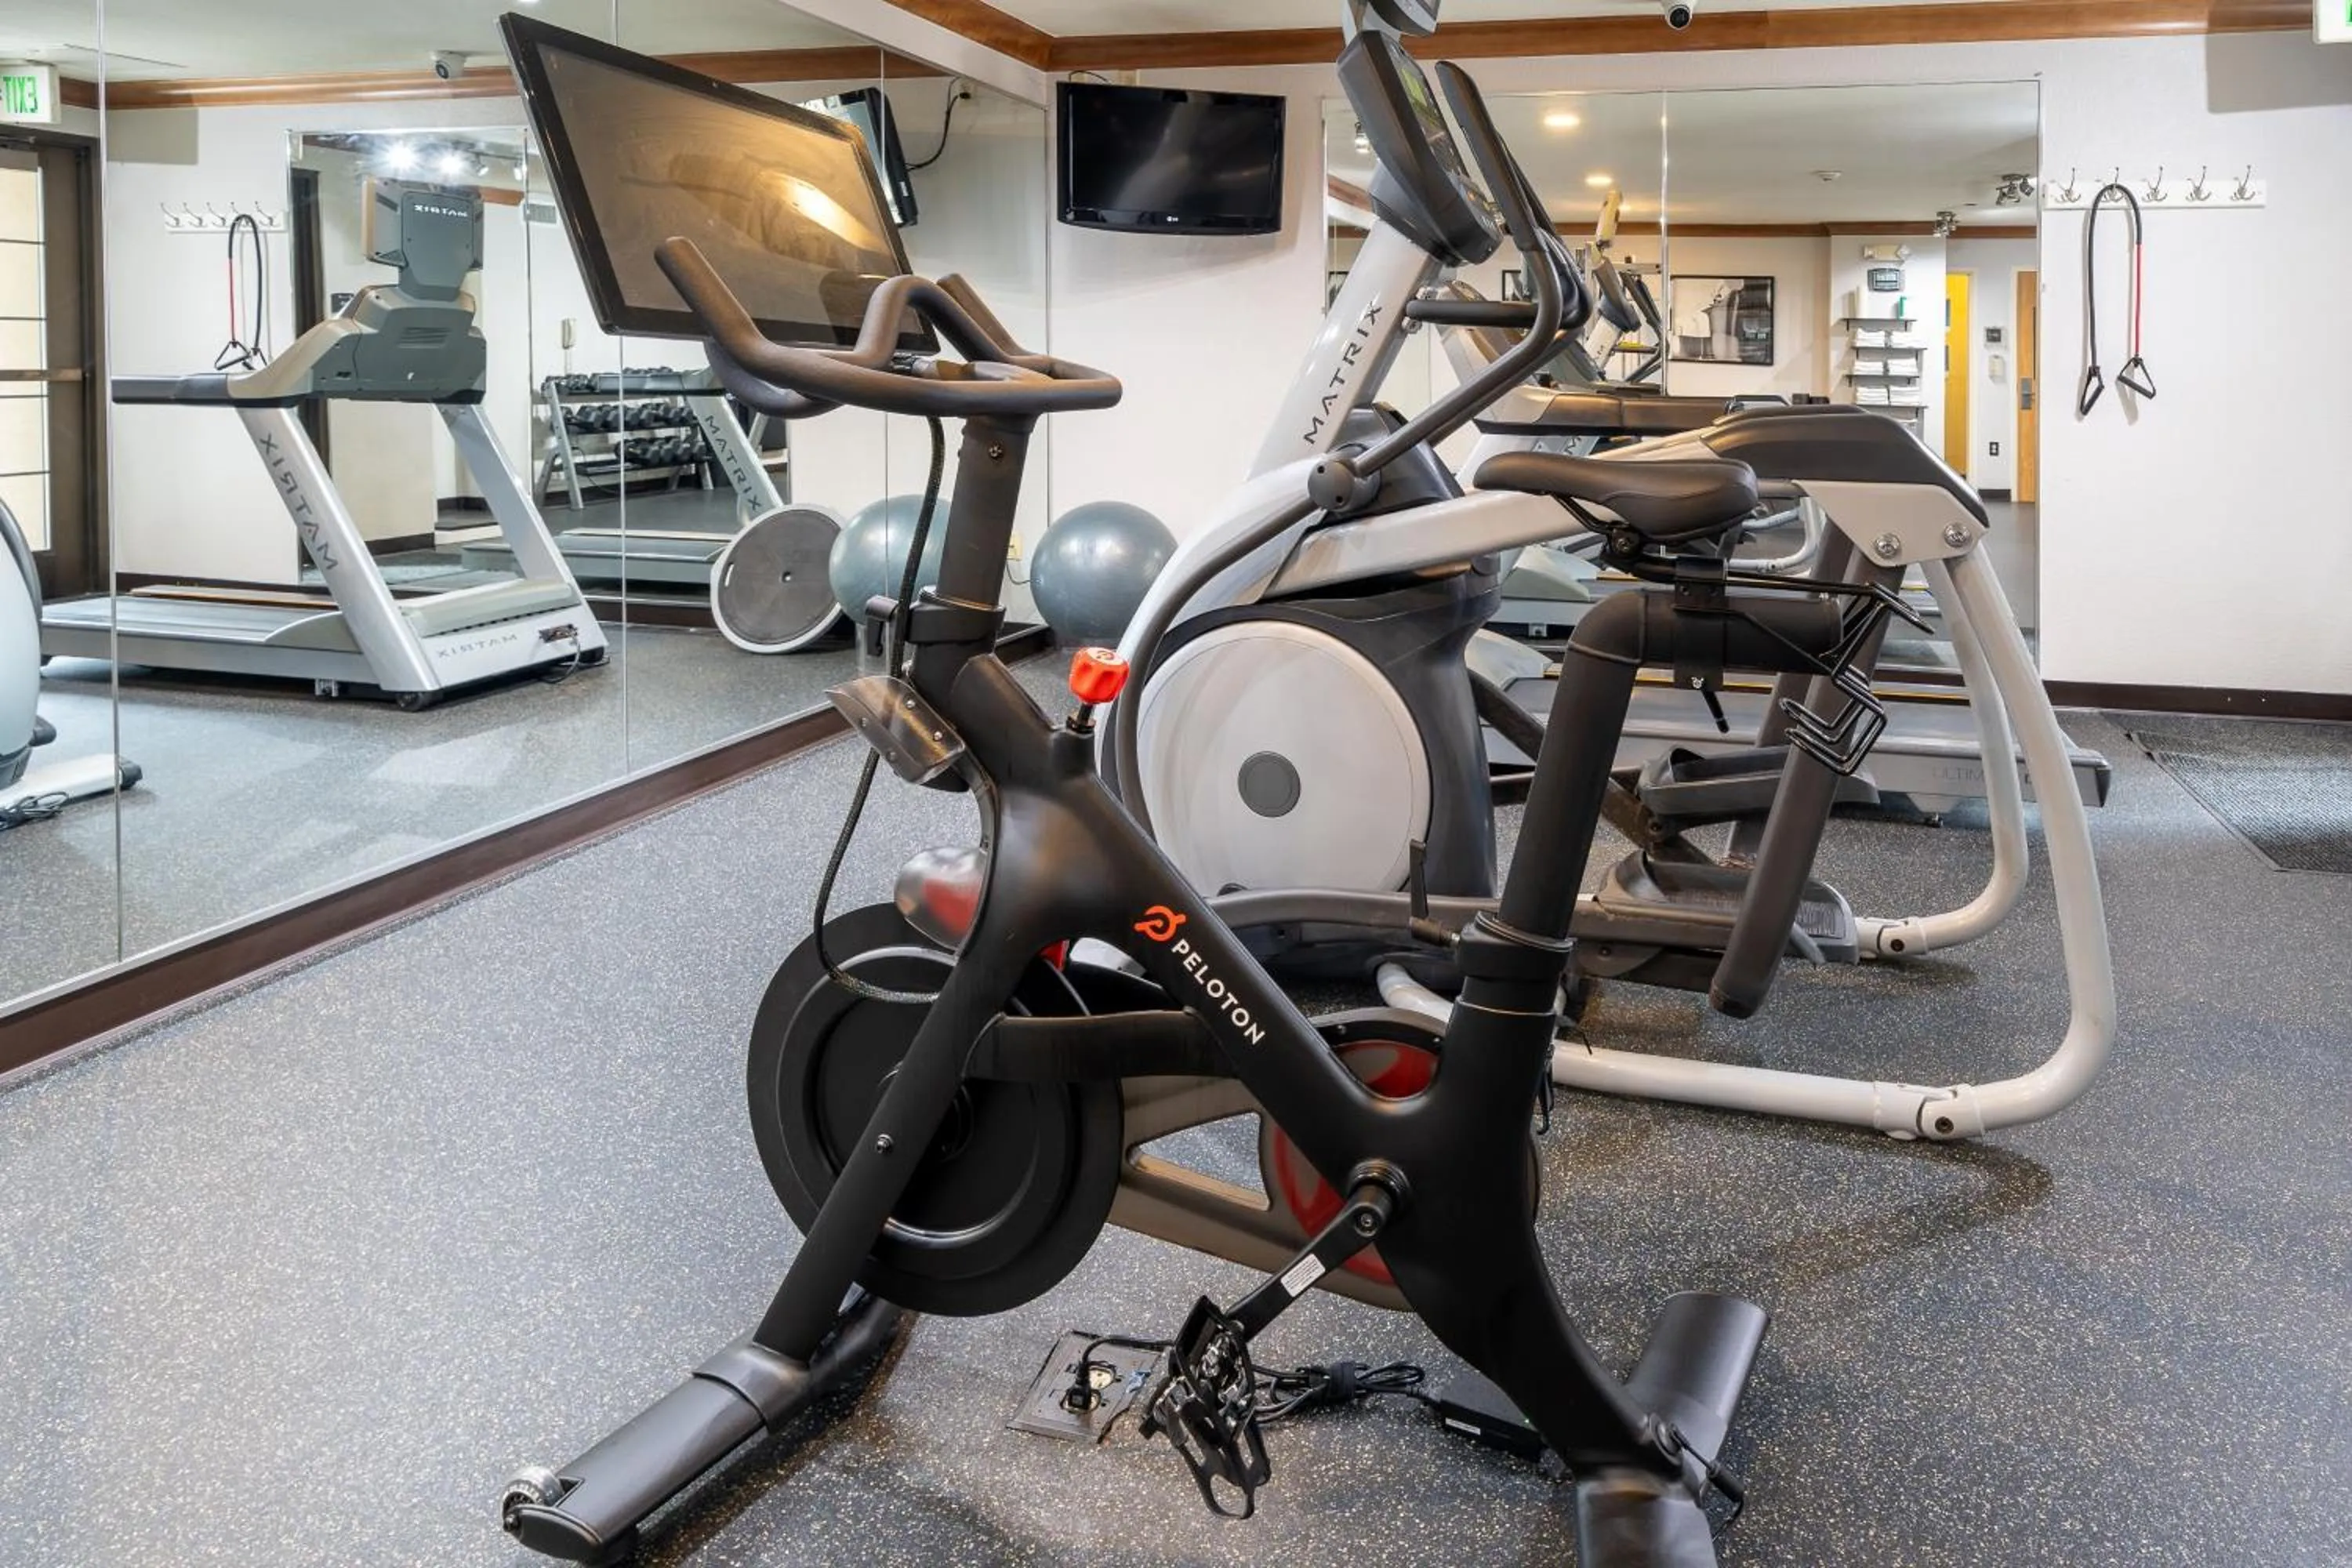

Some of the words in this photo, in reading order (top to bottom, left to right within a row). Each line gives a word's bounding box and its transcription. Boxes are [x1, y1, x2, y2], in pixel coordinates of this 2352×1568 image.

[1303, 302, 1382, 445] MATRIX
[706, 415, 762, 510] MATRIX
[1171, 938, 1265, 1045] PELOTON
